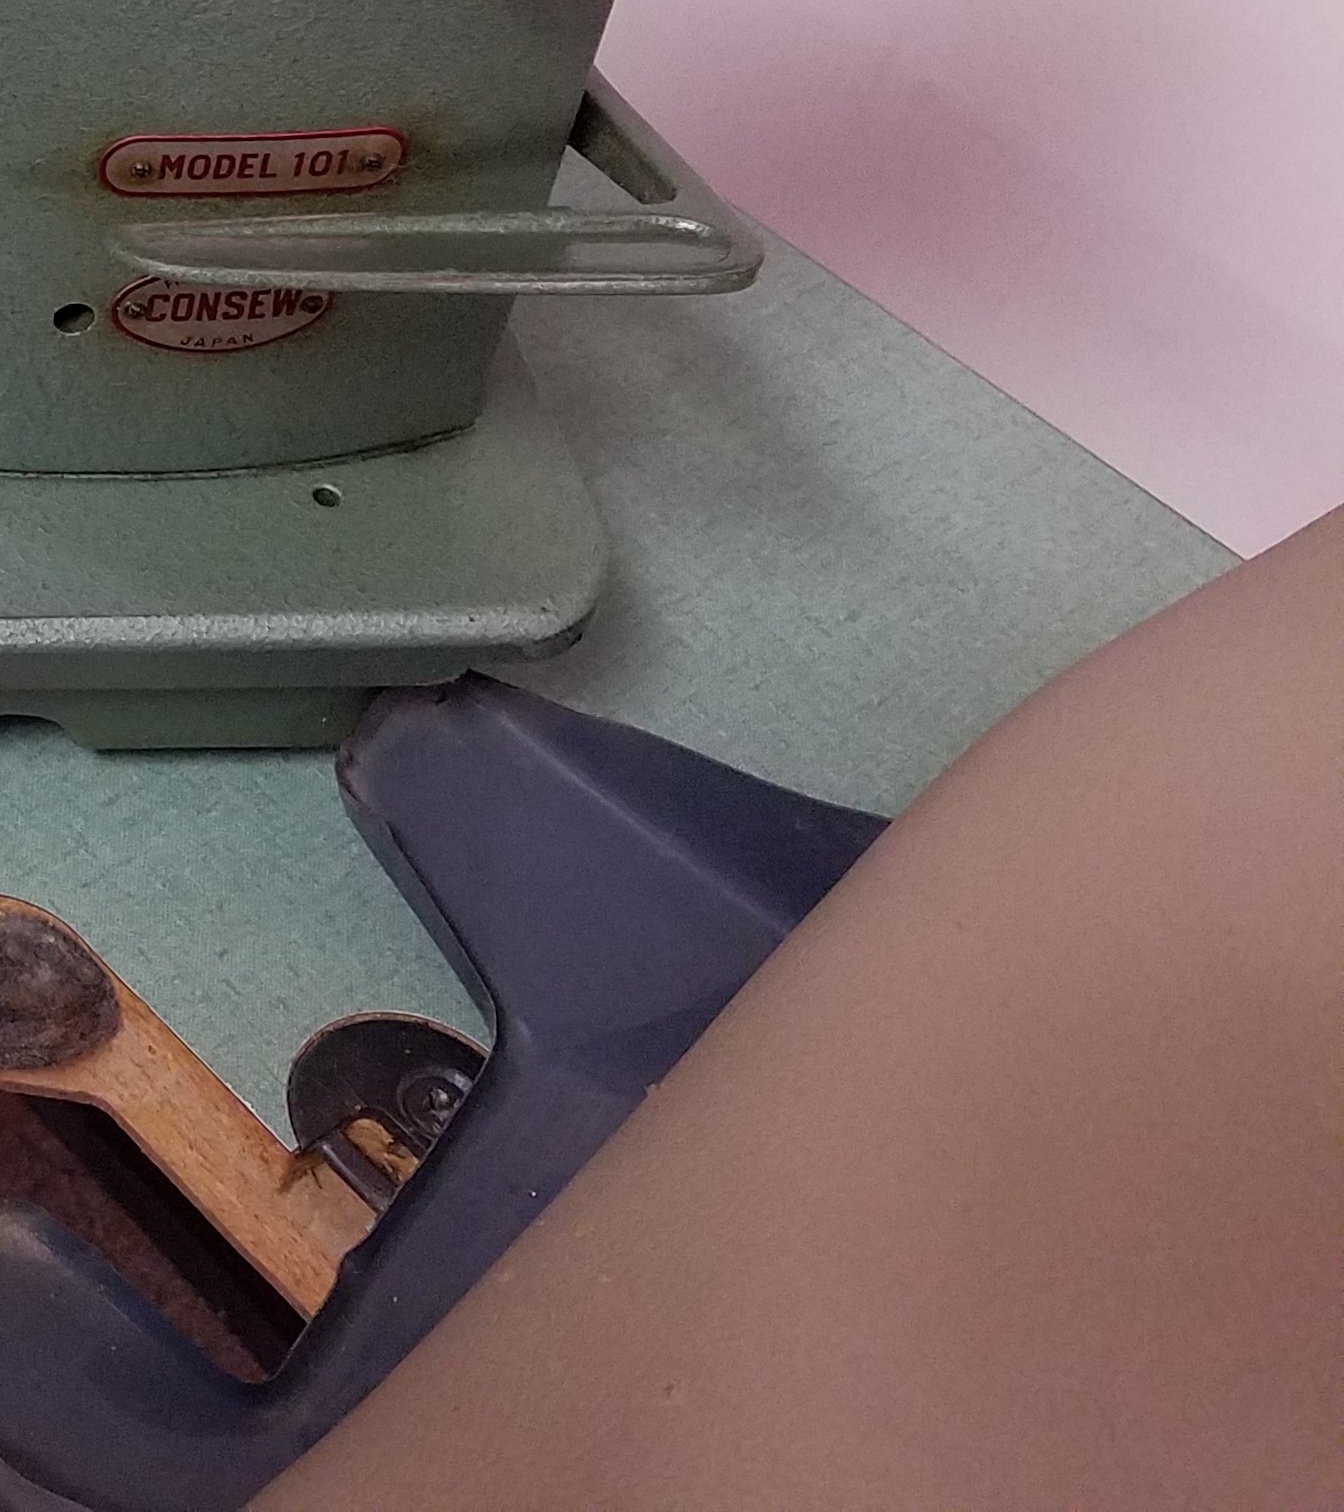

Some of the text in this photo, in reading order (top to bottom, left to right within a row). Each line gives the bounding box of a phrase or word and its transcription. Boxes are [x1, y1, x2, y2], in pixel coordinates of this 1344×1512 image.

[158, 150, 350, 180] MODEL 101
[144, 289, 303, 322] CONSEW
[180, 333, 254, 347] JAPAN
